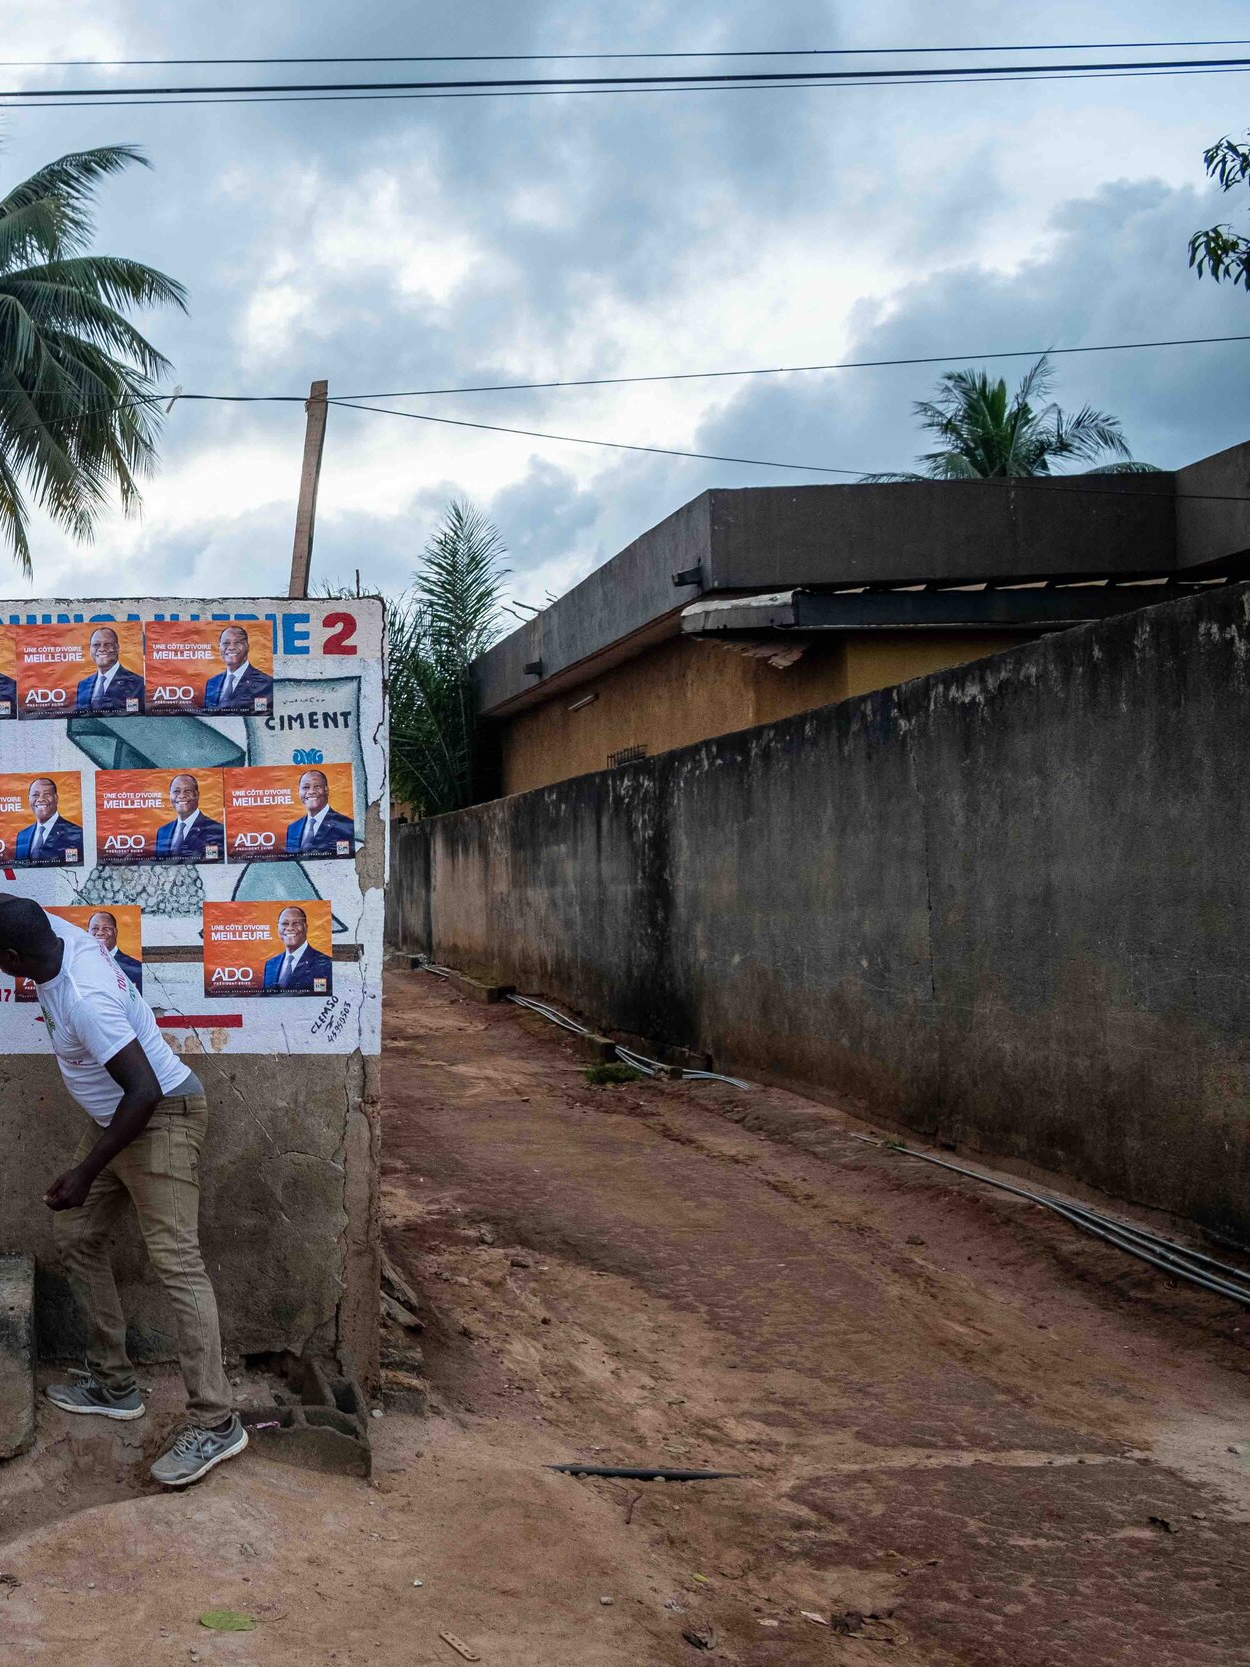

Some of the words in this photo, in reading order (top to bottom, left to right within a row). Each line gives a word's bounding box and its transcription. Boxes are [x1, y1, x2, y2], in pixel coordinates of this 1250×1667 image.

[322, 612, 357, 655] 2
[24, 653, 84, 663] MEILLEURE.
[153, 651, 214, 659] MEILLEURE.
[24, 689, 66, 703] ADO
[153, 686, 194, 700] ADO
[265, 711, 351, 731] CIMENT
[104, 800, 164, 808] MEILLEURE.
[233, 798, 294, 807] MEILLEURE.
[104, 835, 145, 849] ADO
[233, 832, 275, 847] ADO
[211, 933, 273, 941] MEILLEURE.
[211, 968, 253, 982] ADO
[311, 996, 339, 1034] CLEMSO
